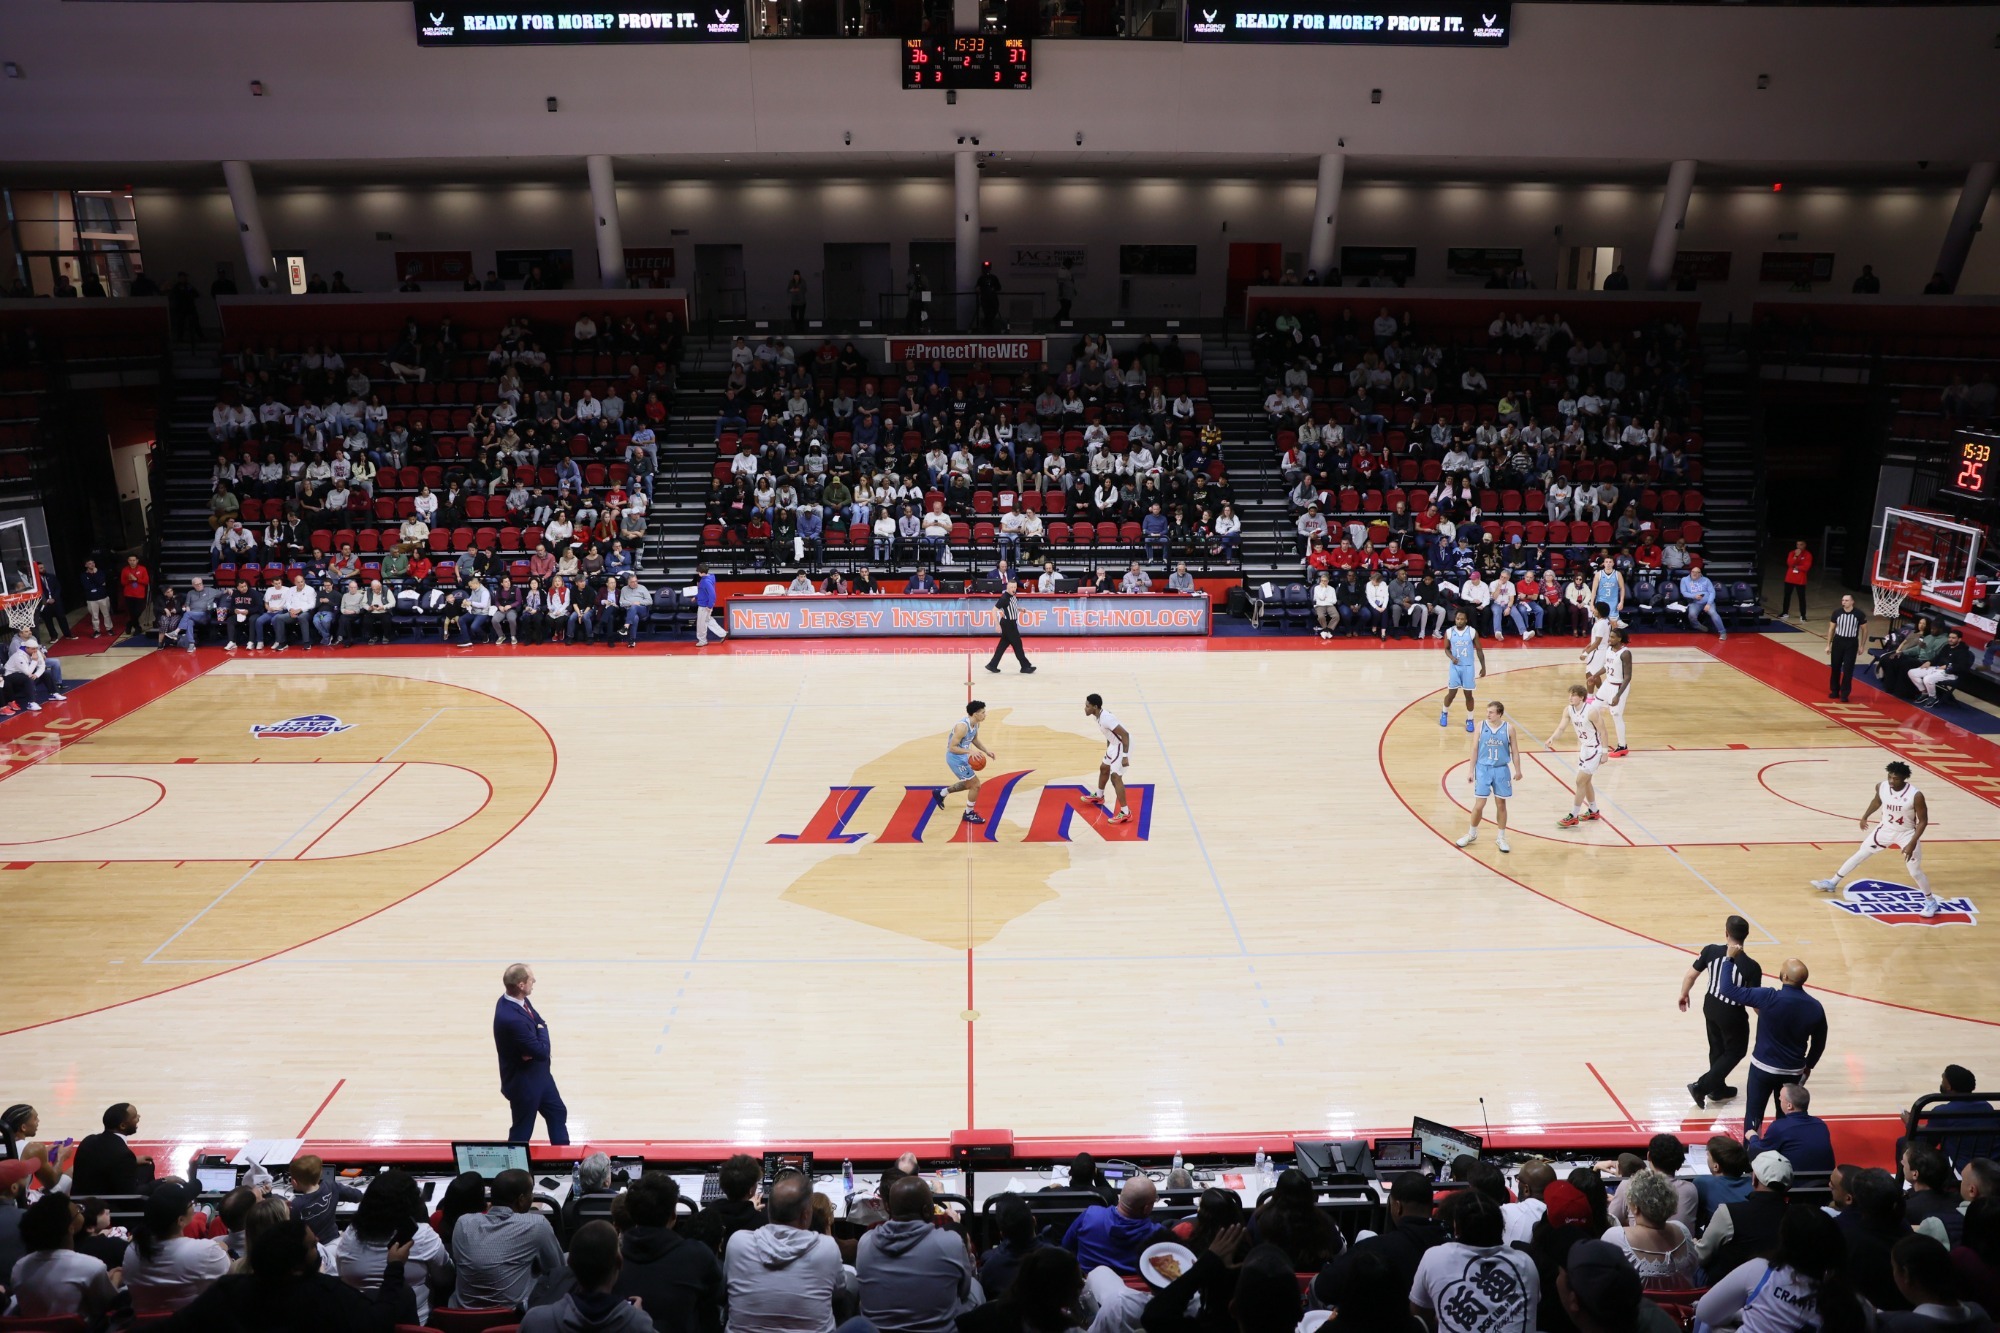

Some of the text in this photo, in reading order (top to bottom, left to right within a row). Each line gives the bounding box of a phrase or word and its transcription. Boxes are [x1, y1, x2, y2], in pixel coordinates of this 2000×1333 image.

[464, 13, 698, 30] READY FOR MORE? PROVE IT.
[1236, 13, 1464, 32] READY FOR MORE? PROVE IT.
[955, 38, 984, 51] 15:33
[912, 49, 928, 62] 36
[964, 56, 970, 66] 2
[1010, 49, 1026, 62] 37
[915, 72, 921, 81] 3
[936, 72, 942, 81] 3
[994, 72, 1000, 81] 3
[1020, 72, 1027, 81] 2
[1015, 250, 1051, 264] JAG
[905, 343, 1028, 358] #ProtectTheWEC
[1964, 443, 1990, 461] 15:33
[1958, 460, 1982, 490] 25
[732, 606, 1203, 629] NEW JERSEY INSTITUT OF TECHNOLOGY
[1456, 648, 1468, 658] 14
[1488, 749, 1498, 760] 11
[764, 769, 1155, 843] NJIT
[1887, 804, 1902, 812] NJIT
[1888, 814, 1904, 825] 24
[1858, 893, 1926, 902] EAST
